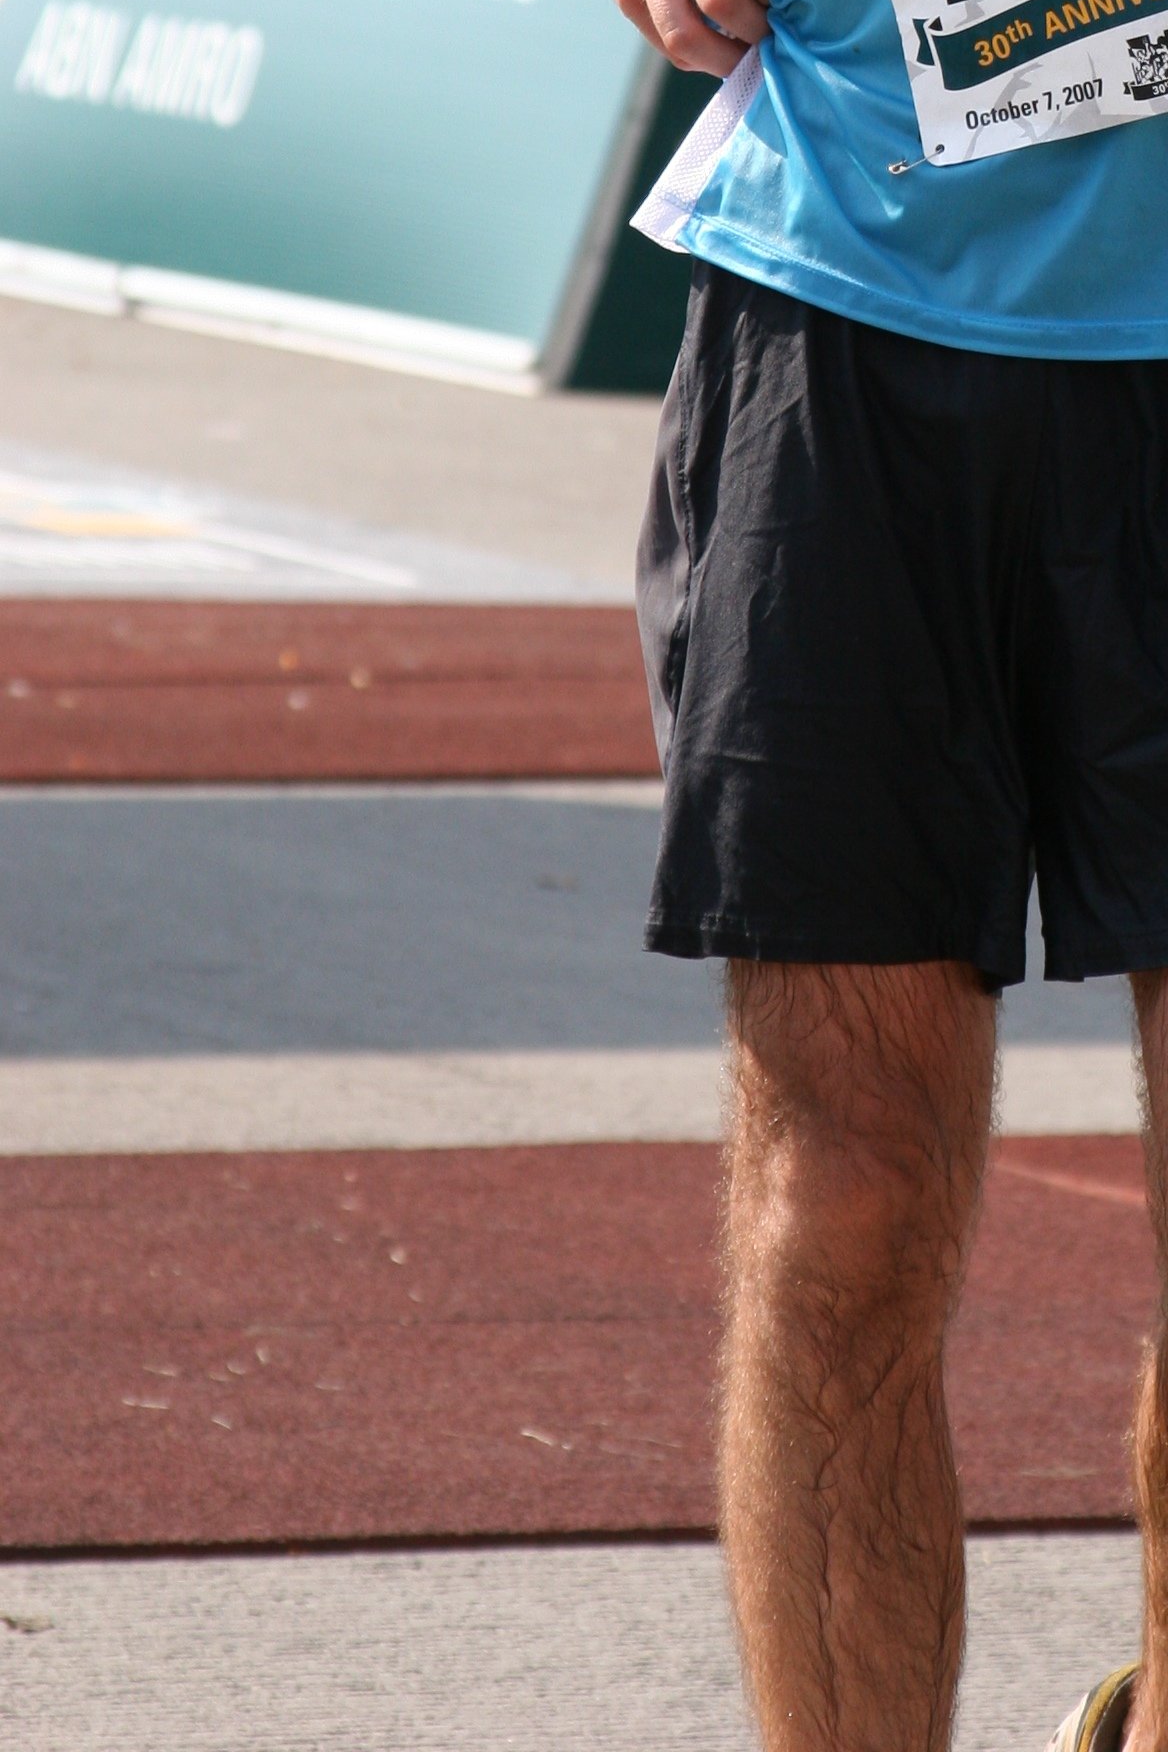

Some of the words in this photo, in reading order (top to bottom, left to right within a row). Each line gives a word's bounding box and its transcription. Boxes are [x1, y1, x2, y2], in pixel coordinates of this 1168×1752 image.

[14, 0, 132, 106] ABN
[111, 12, 264, 128] AMRO
[974, 19, 1033, 67] 30th
[965, 99, 1039, 130] October
[1042, 91, 1060, 111] 7,
[1062, 78, 1103, 106] 2007
